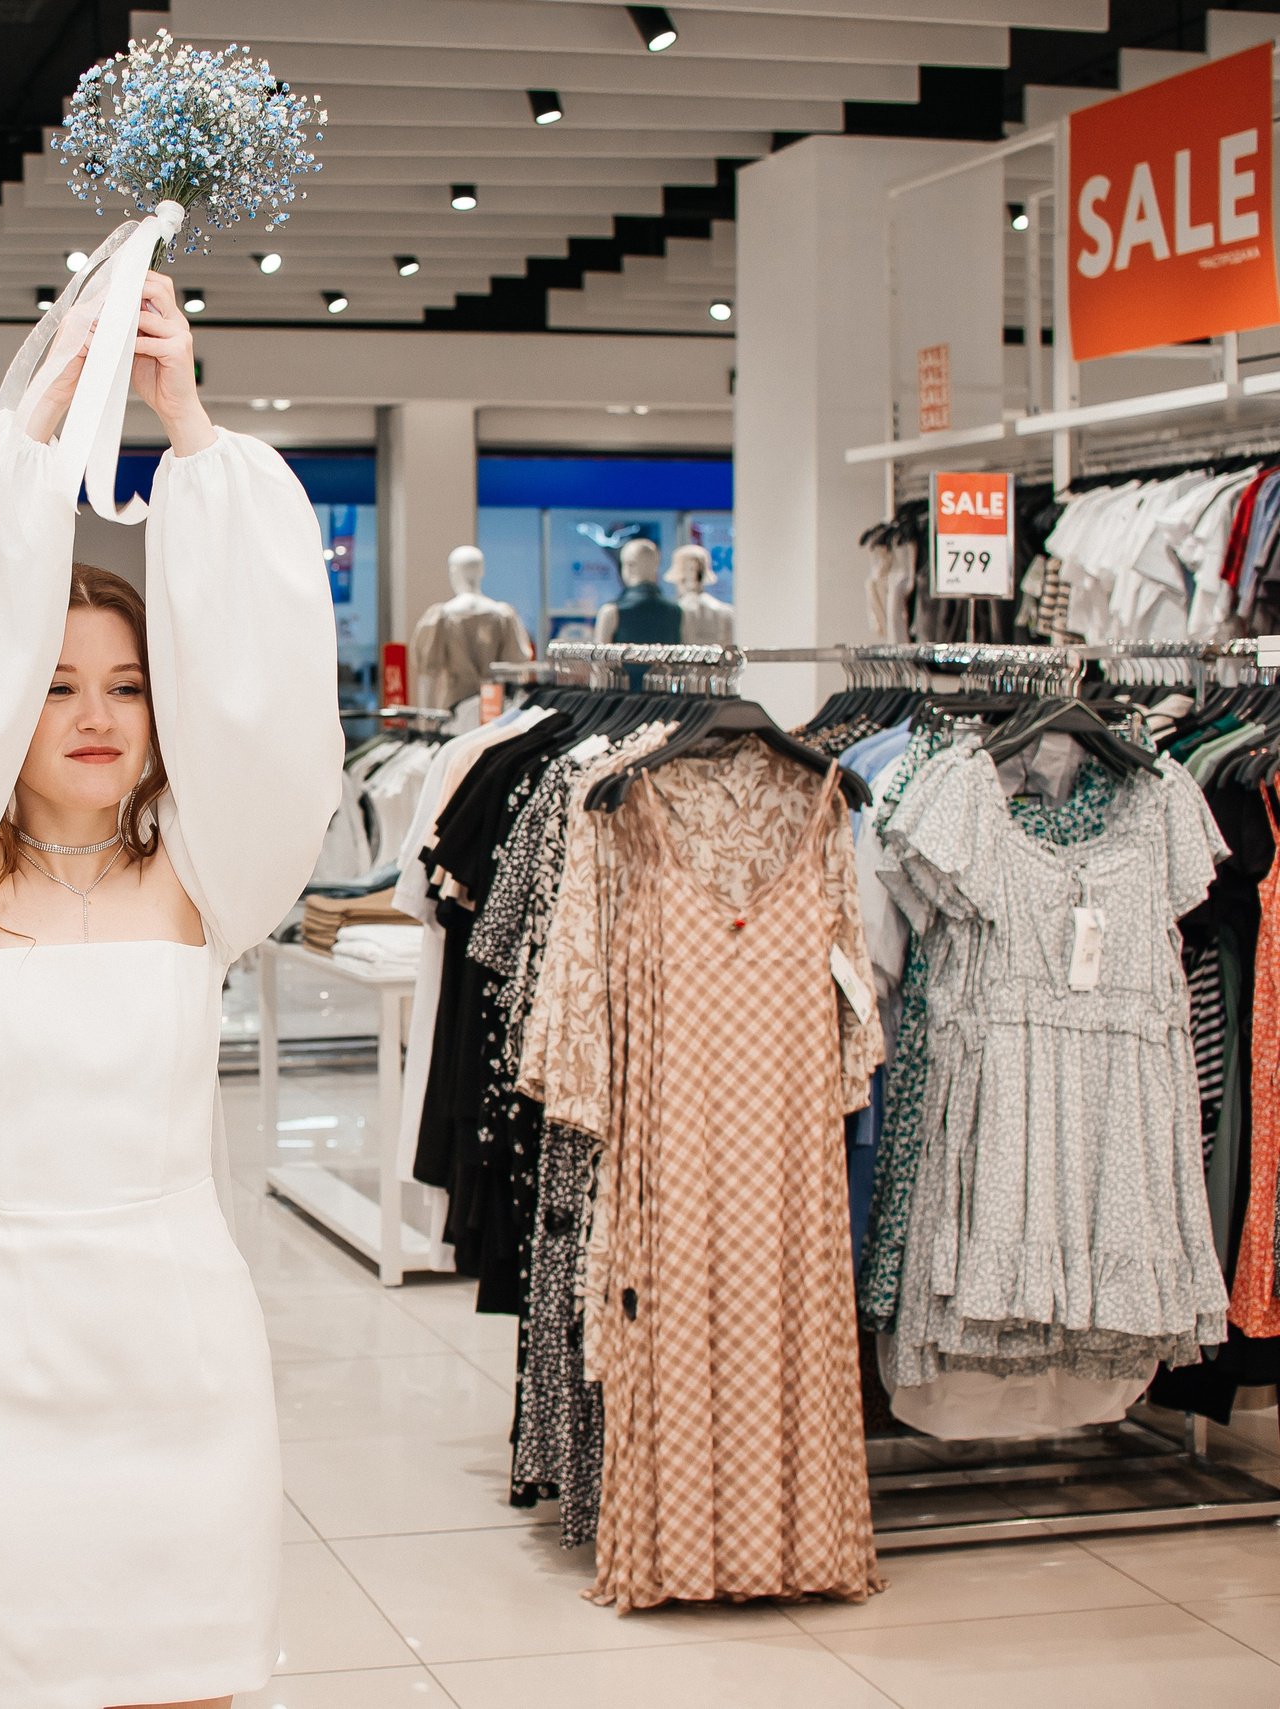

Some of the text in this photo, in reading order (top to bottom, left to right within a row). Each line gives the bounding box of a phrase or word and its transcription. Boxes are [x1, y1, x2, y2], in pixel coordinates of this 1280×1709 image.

[1077, 128, 1260, 280] SALE
[940, 490, 1005, 516] SALE
[948, 550, 991, 573] 799
